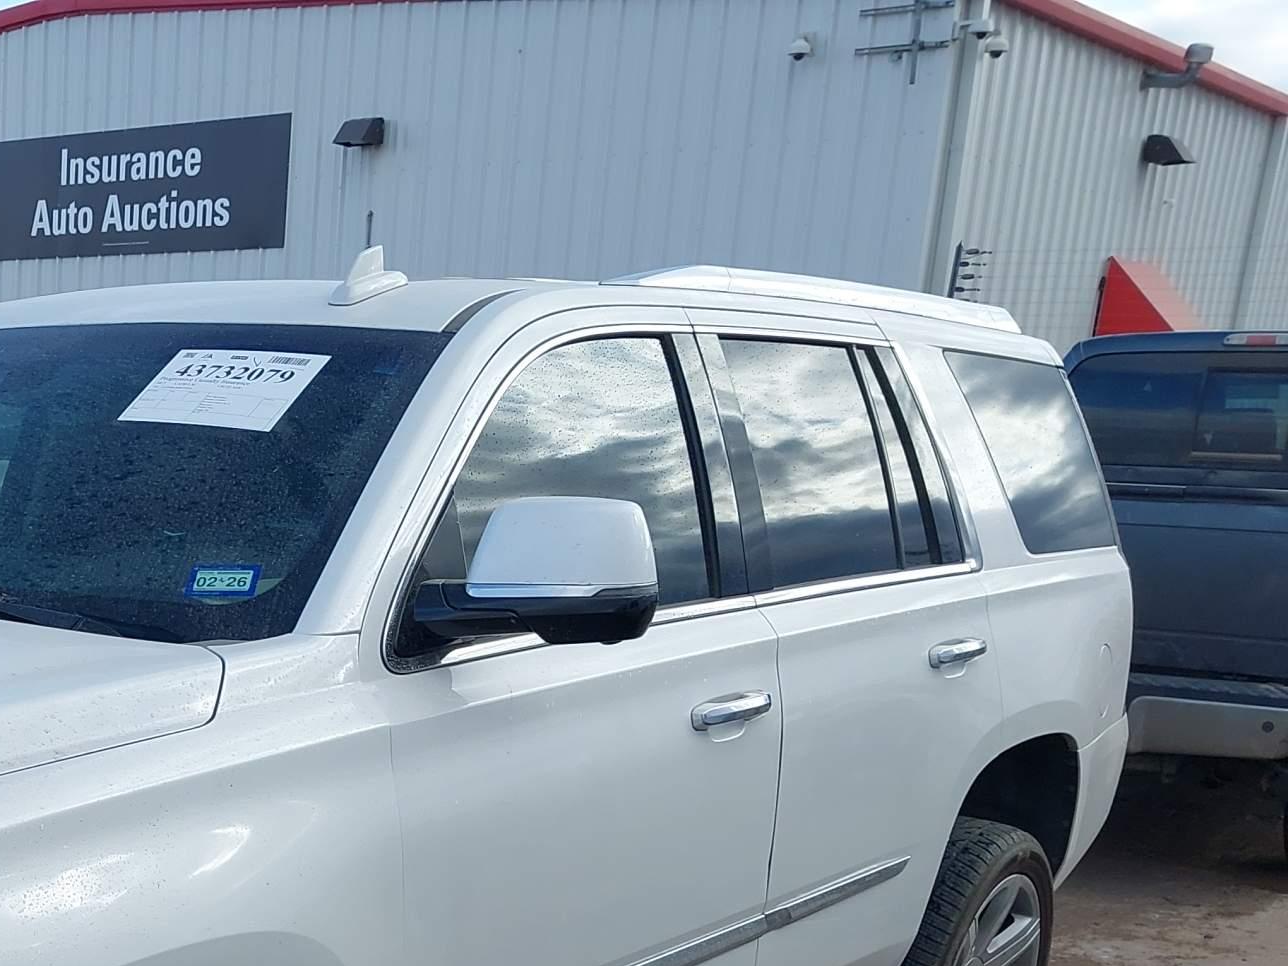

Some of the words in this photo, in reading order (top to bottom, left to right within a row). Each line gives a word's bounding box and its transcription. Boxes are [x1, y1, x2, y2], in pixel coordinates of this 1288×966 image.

[60, 147, 201, 187] Insurance
[31, 199, 93, 237] Auto
[101, 190, 230, 233] Auctions
[175, 363, 296, 384] 43732079
